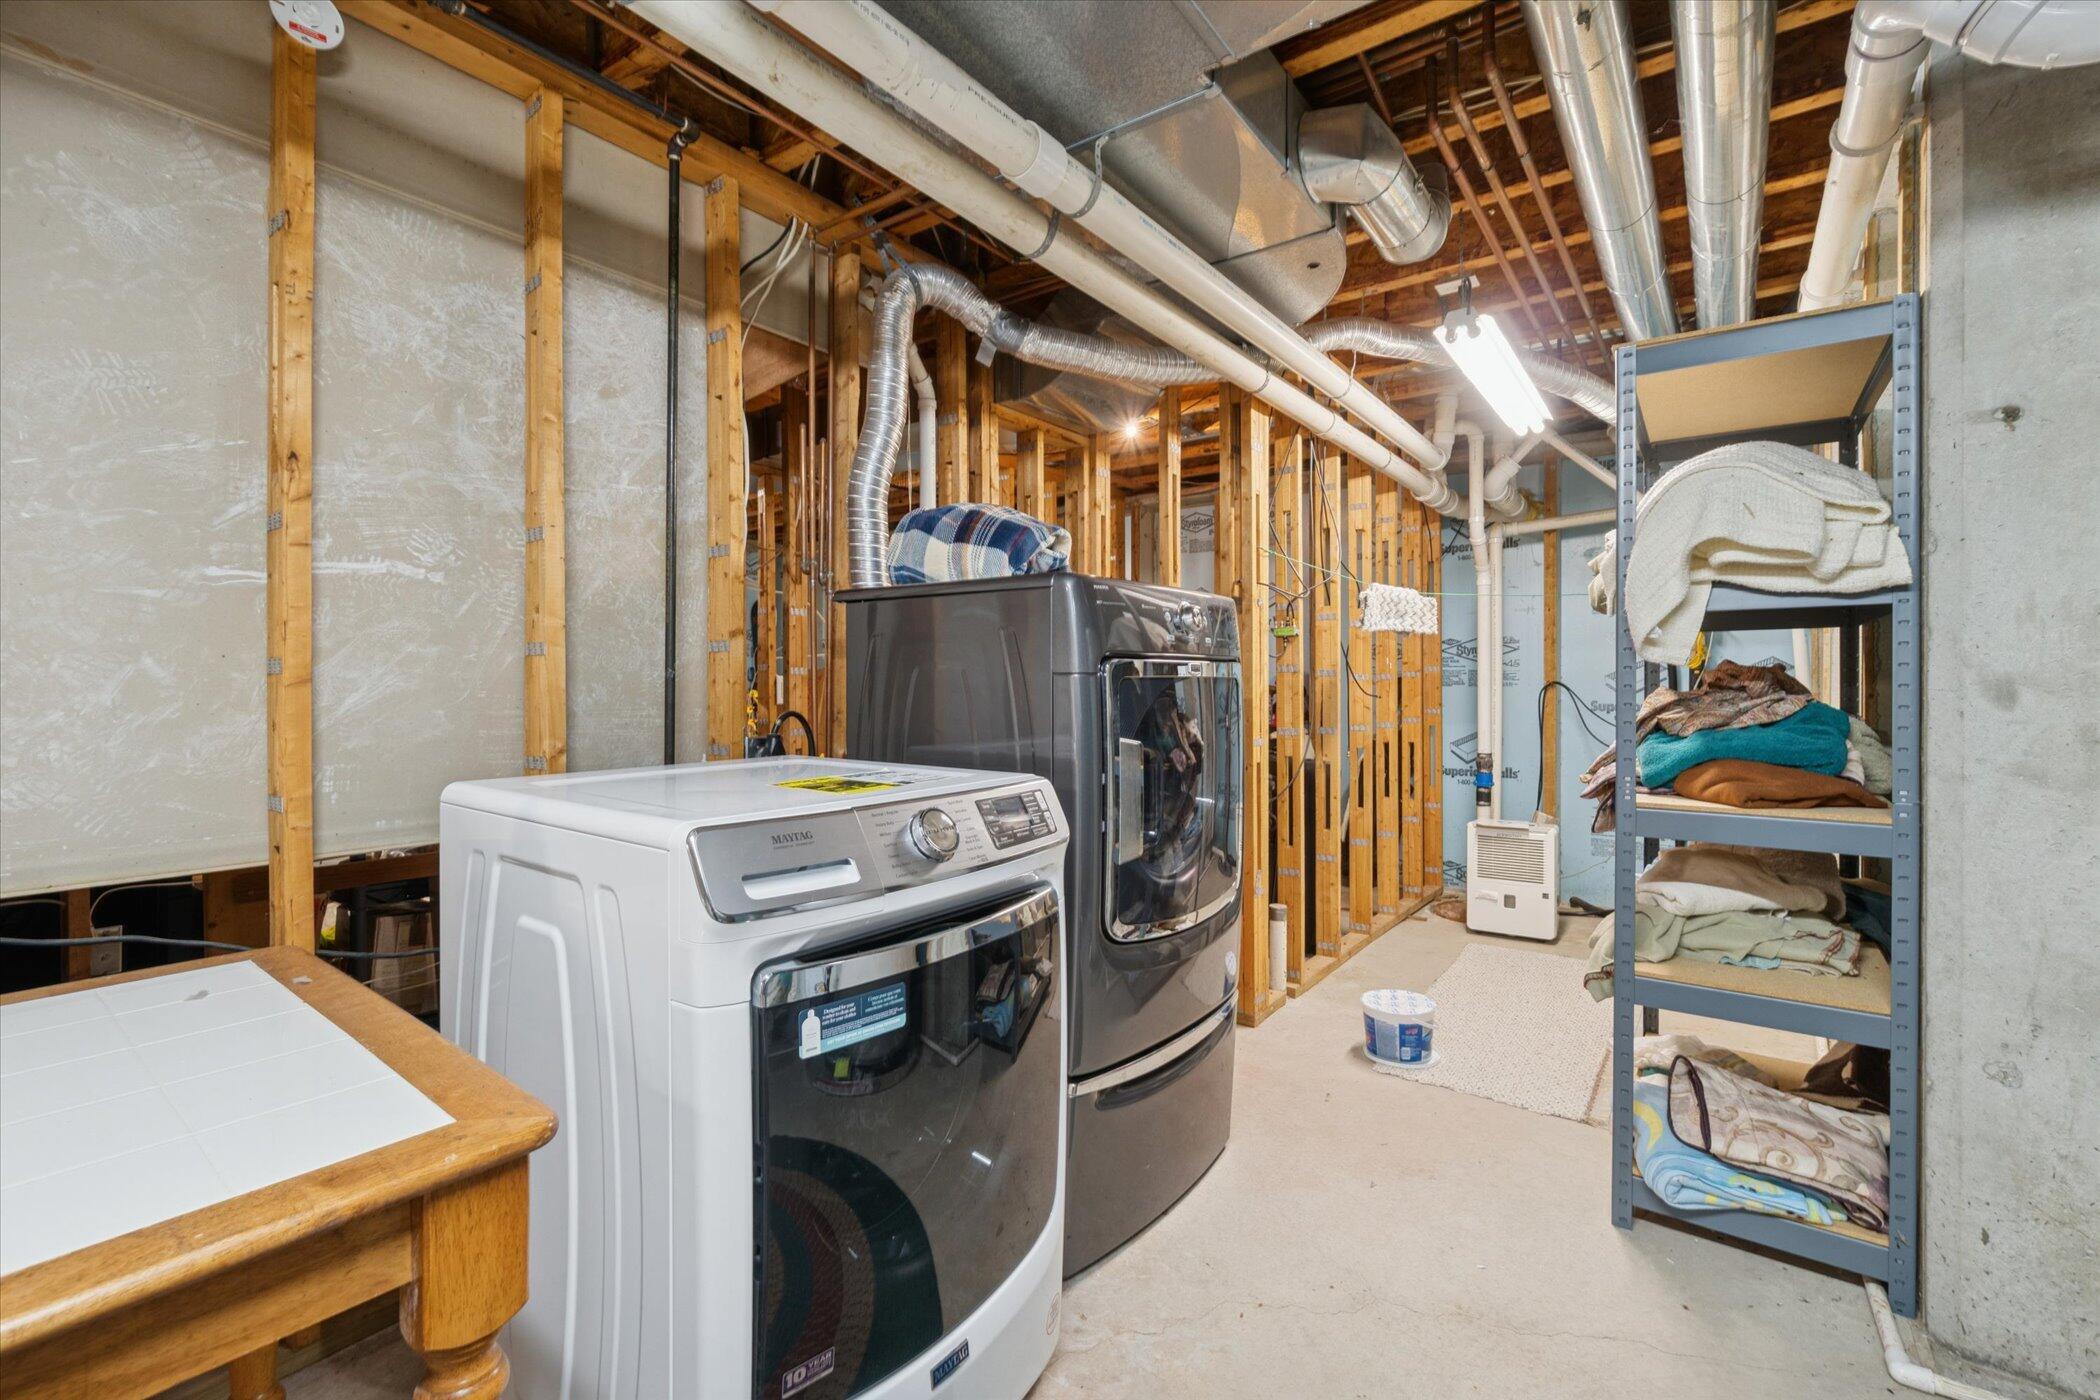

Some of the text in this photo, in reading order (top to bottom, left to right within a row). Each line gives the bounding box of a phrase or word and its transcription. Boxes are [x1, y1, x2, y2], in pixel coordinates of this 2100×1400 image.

[771, 831, 814, 845] MAYTAG
[934, 1344, 968, 1384] MAYTAG
[785, 1366, 807, 1390] 10
